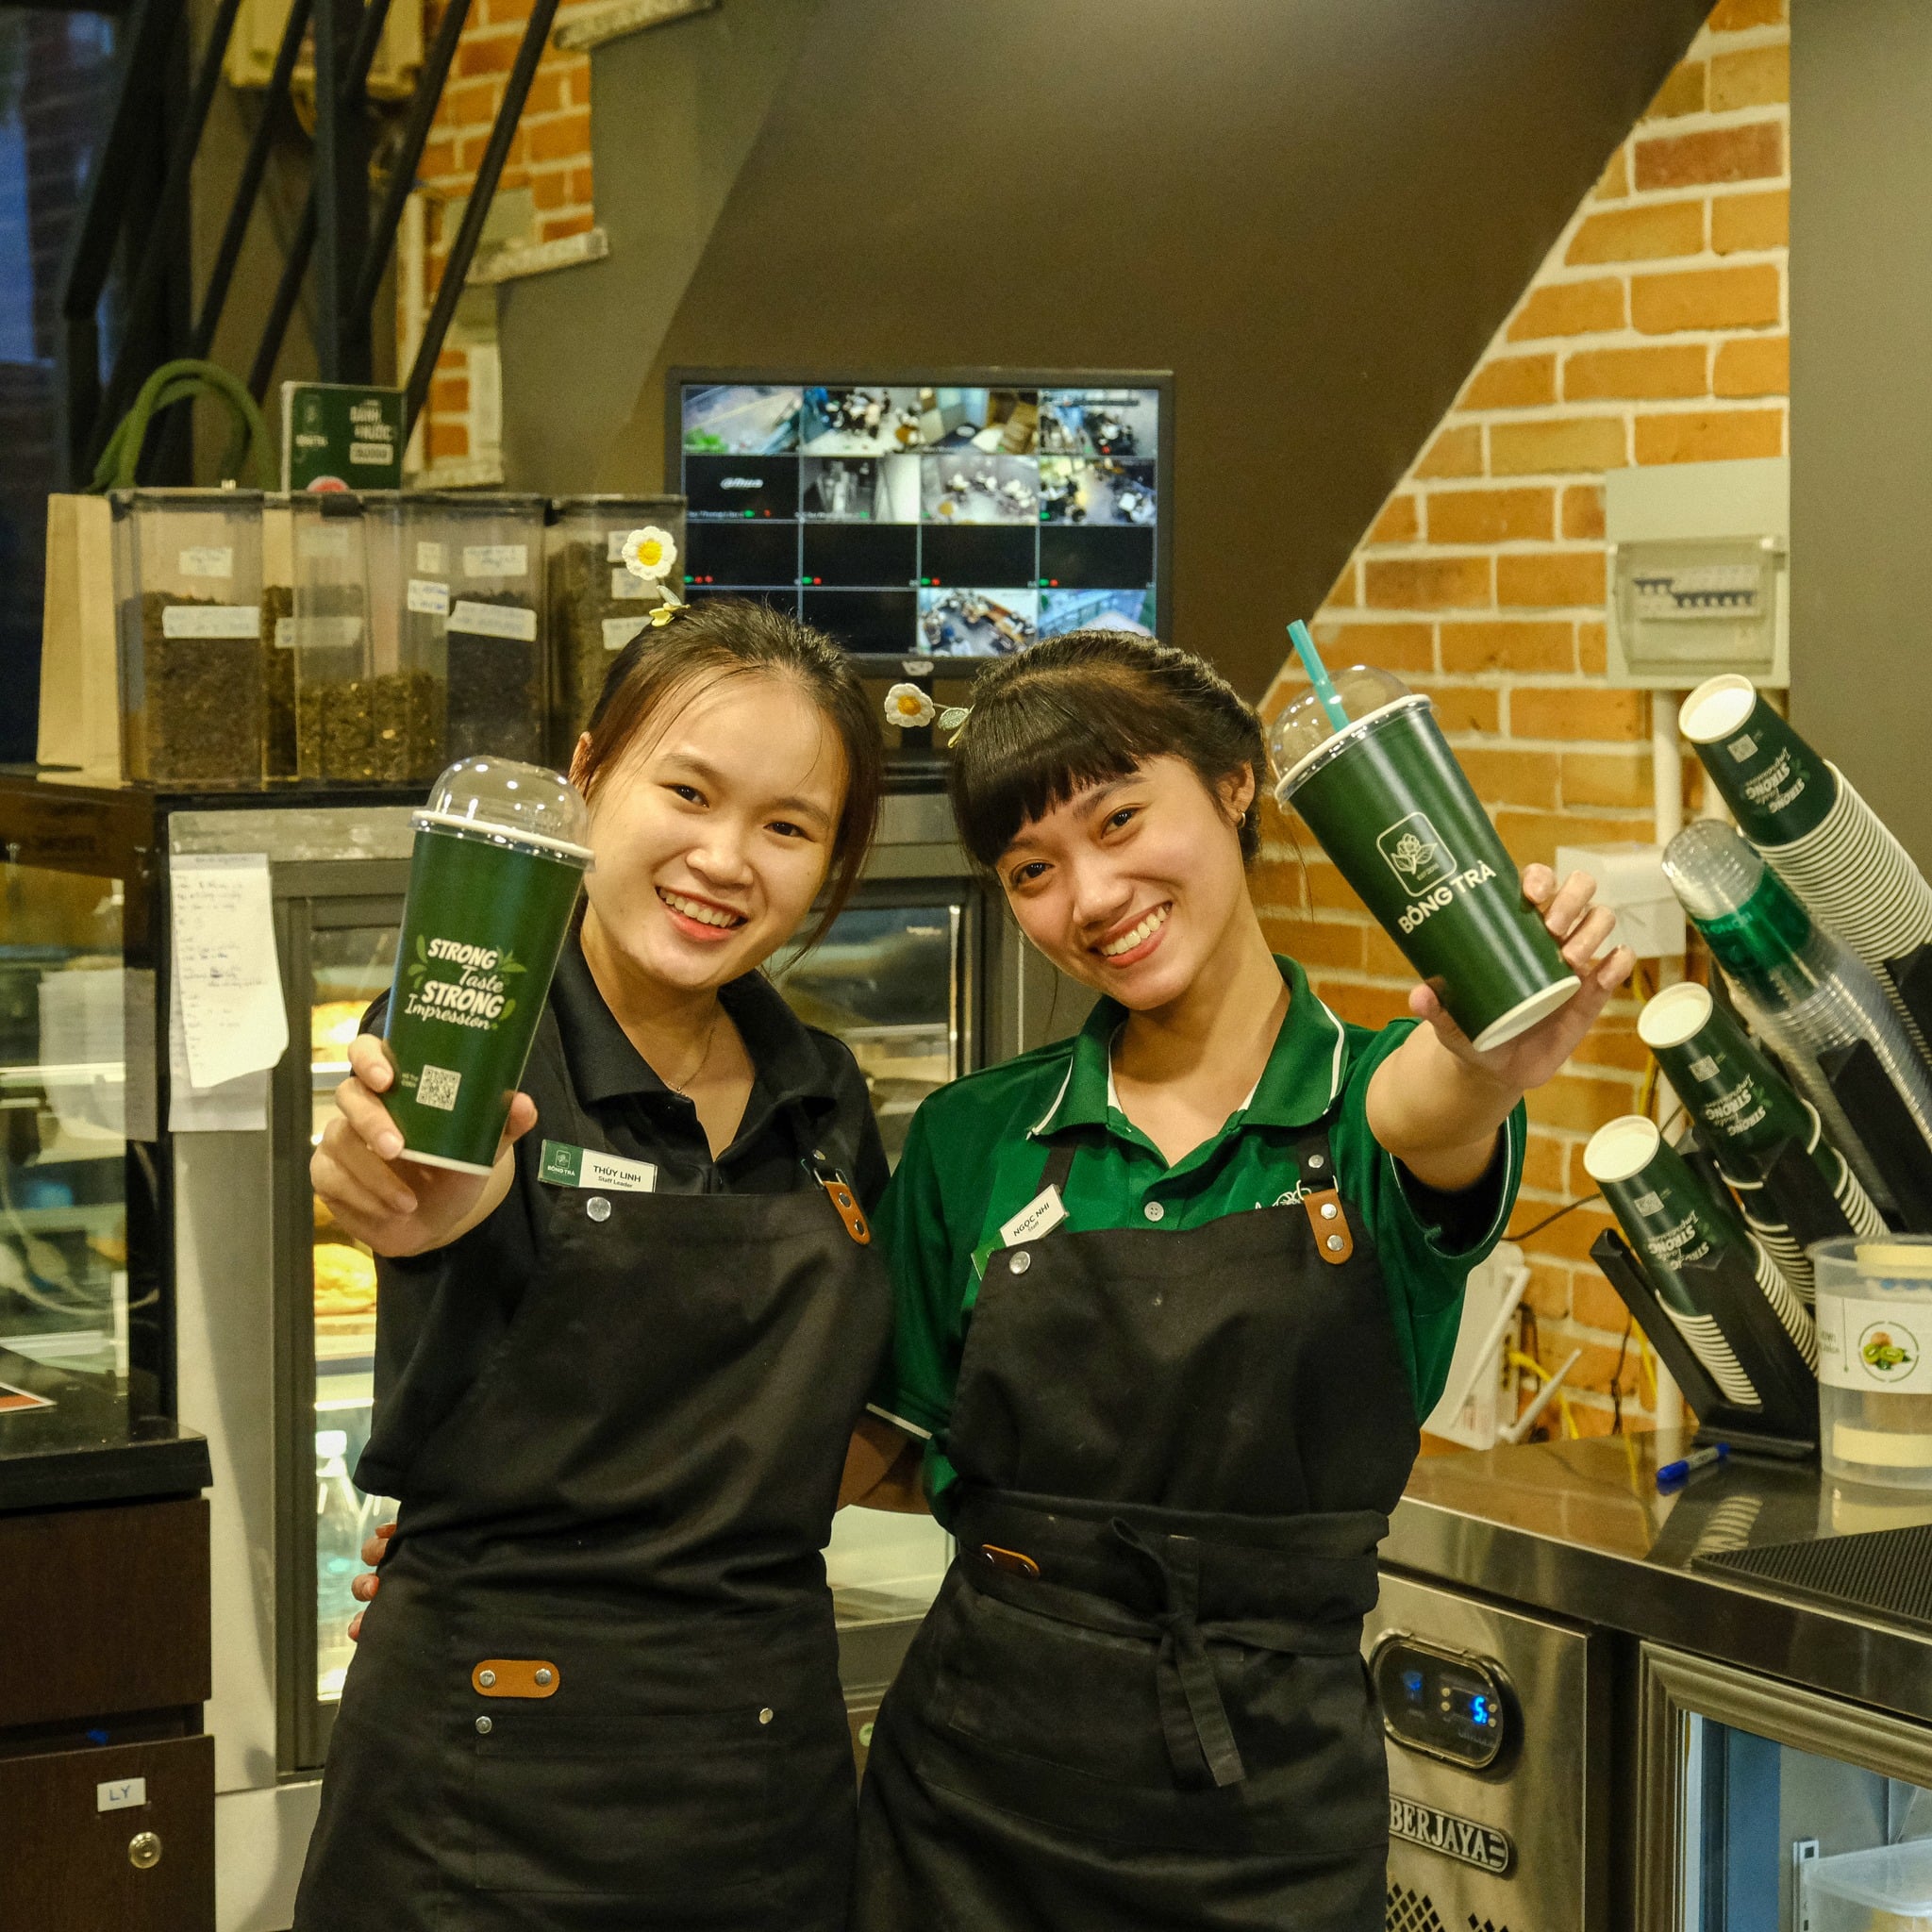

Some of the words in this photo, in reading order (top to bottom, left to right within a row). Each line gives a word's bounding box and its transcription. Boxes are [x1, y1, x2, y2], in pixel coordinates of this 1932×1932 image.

[1745, 761, 1790, 800] STRONG
[1397, 886, 1454, 934] BÔNG
[1449, 859, 1497, 893] TRÀ
[427, 938, 498, 970] STRONG
[458, 964, 505, 993] Taste
[421, 980, 505, 1019] STRONG
[1705, 1089, 1752, 1121] STRONG
[598, 1175, 612, 1185] Staff
[613, 1177, 633, 1189] Leader
[619, 1171, 641, 1183] LINH
[1035, 1202, 1050, 1218] NHI
[1648, 1224, 1696, 1255] STRONG
[108, 1785, 130, 1802] LY
[1390, 1800, 1490, 1864] BERJAYA
